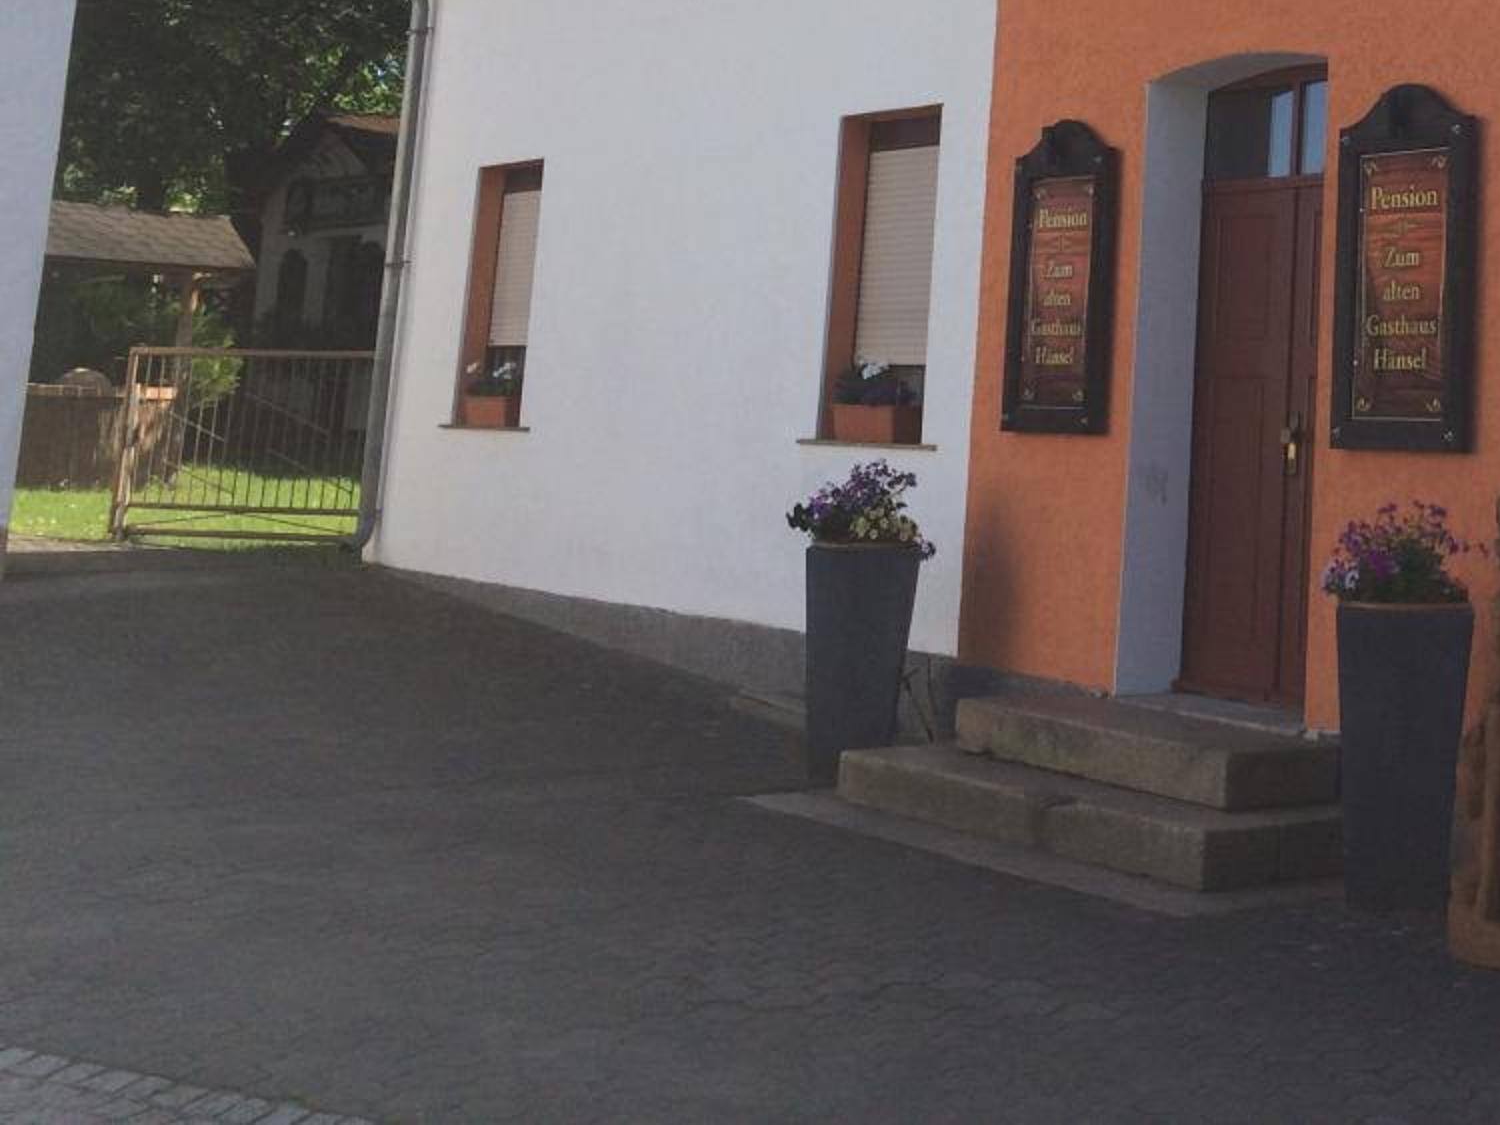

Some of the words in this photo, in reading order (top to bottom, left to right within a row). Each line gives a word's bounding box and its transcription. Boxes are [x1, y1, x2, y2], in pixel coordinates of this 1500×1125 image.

[1370, 185, 1438, 210] Pension
[1384, 246, 1421, 268] Zum
[1383, 279, 1420, 302] alten
[1367, 314, 1437, 336] Gasthaus
